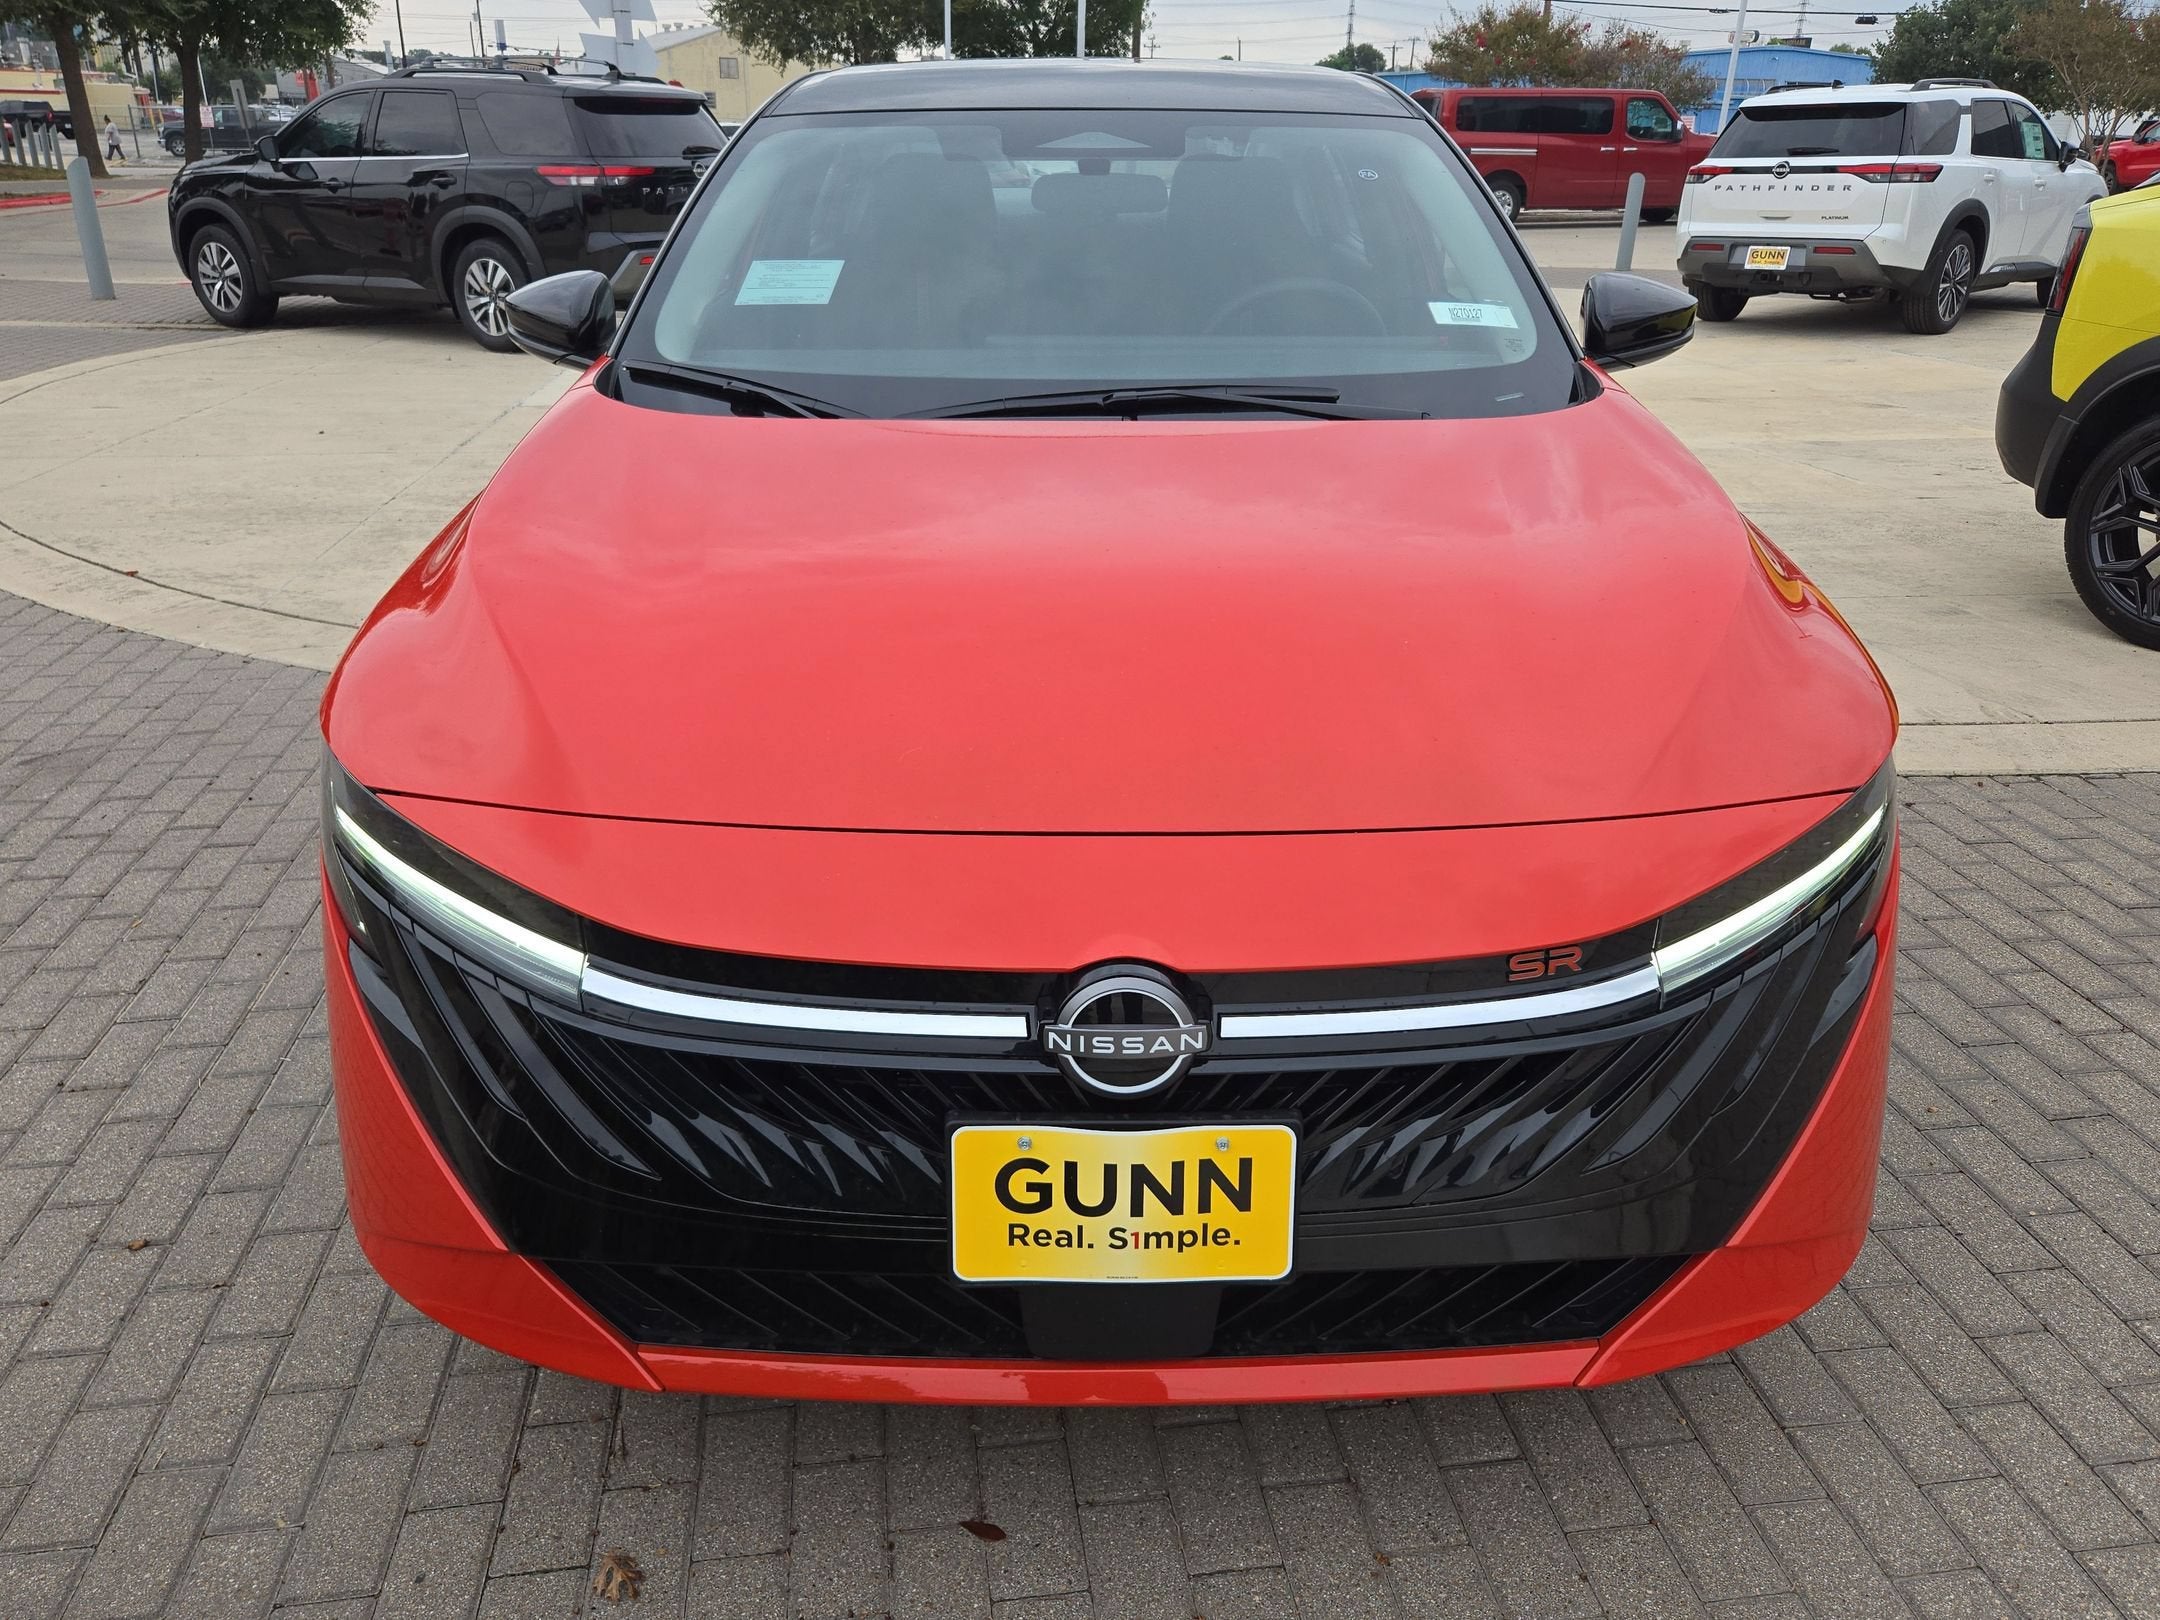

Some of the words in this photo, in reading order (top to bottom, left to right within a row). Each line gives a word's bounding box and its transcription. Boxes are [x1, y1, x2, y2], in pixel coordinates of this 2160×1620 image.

[1714, 184, 1852, 192] PATHFINDER
[1751, 250, 1785, 260] GUNN
[1508, 945, 1583, 981] SR
[1048, 1031, 1203, 1055] NISSAN
[994, 1157, 1253, 1218] GUNN
[1008, 1223, 1094, 1249] Real.
[1108, 1222, 1241, 1253] S1mple.
